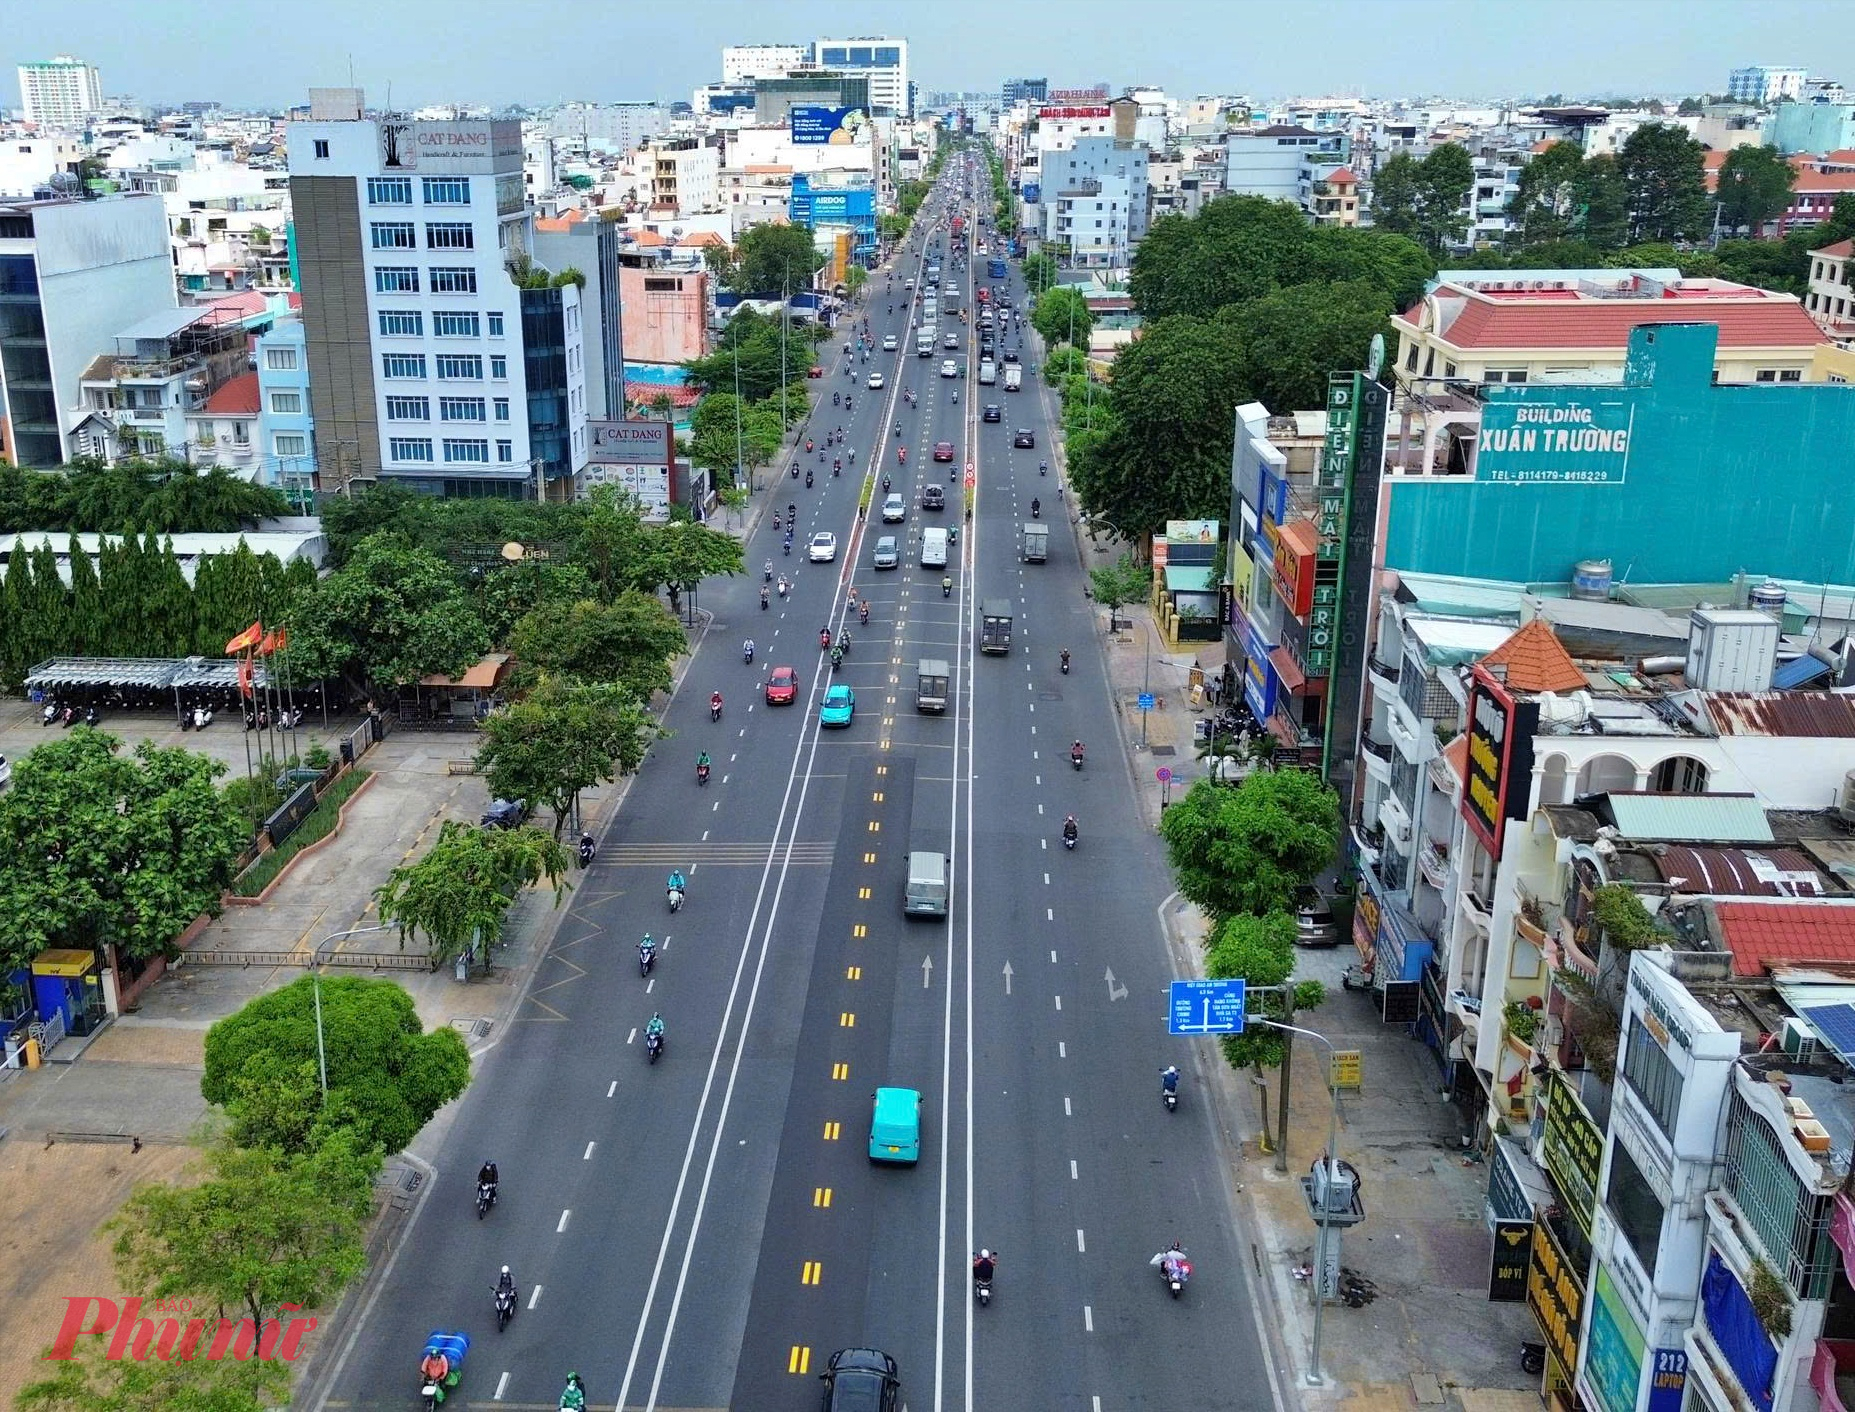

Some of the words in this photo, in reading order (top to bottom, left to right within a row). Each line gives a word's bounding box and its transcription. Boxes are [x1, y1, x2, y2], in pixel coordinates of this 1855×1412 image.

[418, 133, 445, 145] CAT
[447, 133, 487, 145] DANG
[815, 196, 846, 204] AIRDOG
[1516, 408, 1592, 424] BUILDING
[608, 429, 630, 439] CAT
[632, 430, 662, 439] DANG
[1480, 424, 1537, 452] XUÂN
[1543, 423, 1627, 453] TRƯỜNG
[1660, 1352, 1685, 1372] 212
[1653, 1371, 1684, 1389] LAPTOP
